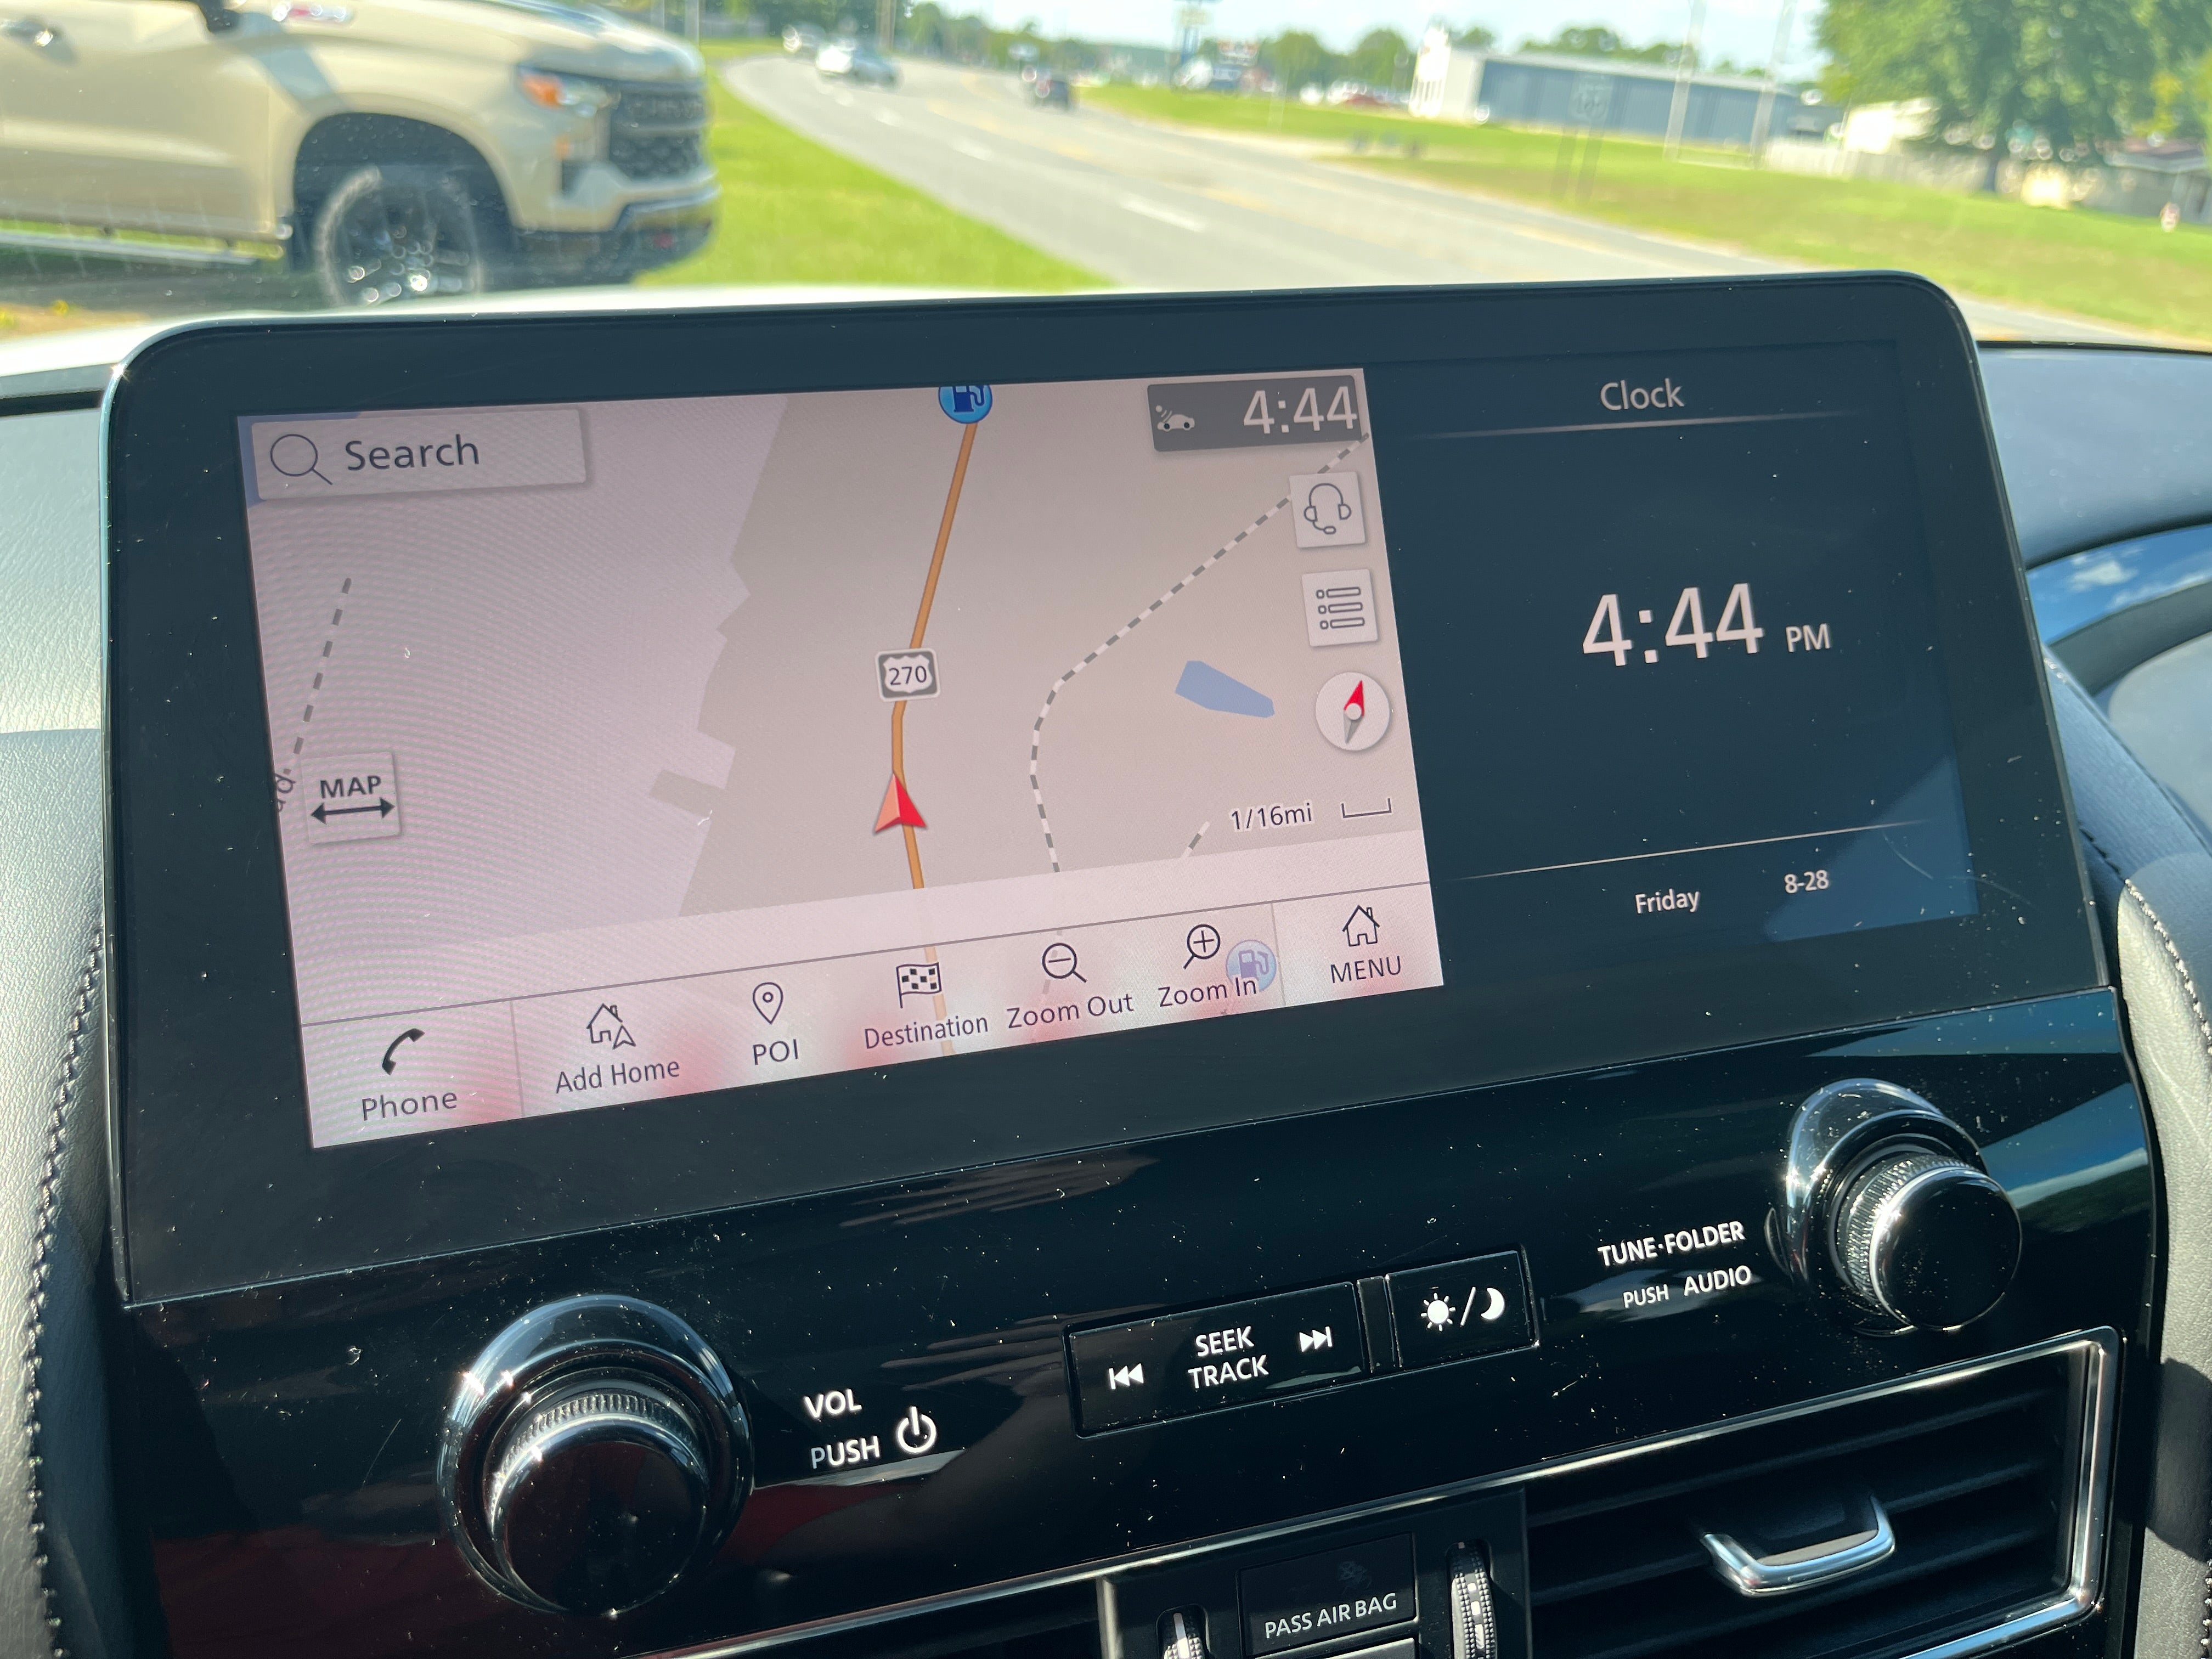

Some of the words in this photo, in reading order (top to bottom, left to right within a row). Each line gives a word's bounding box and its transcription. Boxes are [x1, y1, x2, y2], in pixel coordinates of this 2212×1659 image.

[1600, 377, 1685, 410] Clock
[1243, 386, 1357, 434] 4:44
[345, 433, 479, 471] Search
[1583, 583, 1764, 667] 4:44
[1786, 623, 1830, 652] PM
[889, 665, 927, 686] 270
[320, 775, 382, 799] MAP
[1232, 802, 1312, 830] 1/16mi
[1784, 870, 1829, 894] 8-28
[1635, 888, 1700, 914] Friday
[1330, 955, 1401, 984] MENU
[1158, 984, 1228, 1007] Zoom
[1235, 977, 1257, 997] In
[1007, 1005, 1080, 1029] Zoom
[1087, 994, 1134, 1017] Out
[864, 1015, 988, 1049] Destination
[753, 1039, 799, 1065] POI
[556, 1064, 602, 1094] Add
[611, 1061, 680, 1086] Home
[362, 1092, 458, 1121] Phone
[1623, 1284, 1669, 1308] PUSH
[1684, 1265, 1752, 1296] AUDIO
[1195, 1325, 1254, 1357] SEEK
[1187, 1353, 1269, 1389] TRACK
[804, 1389, 862, 1419] VOL
[811, 1436, 880, 1469] PUSH
[1265, 1612, 1312, 1639] PASS
[1317, 1604, 1351, 1627] AIR
[1355, 1593, 1397, 1618] BAG
